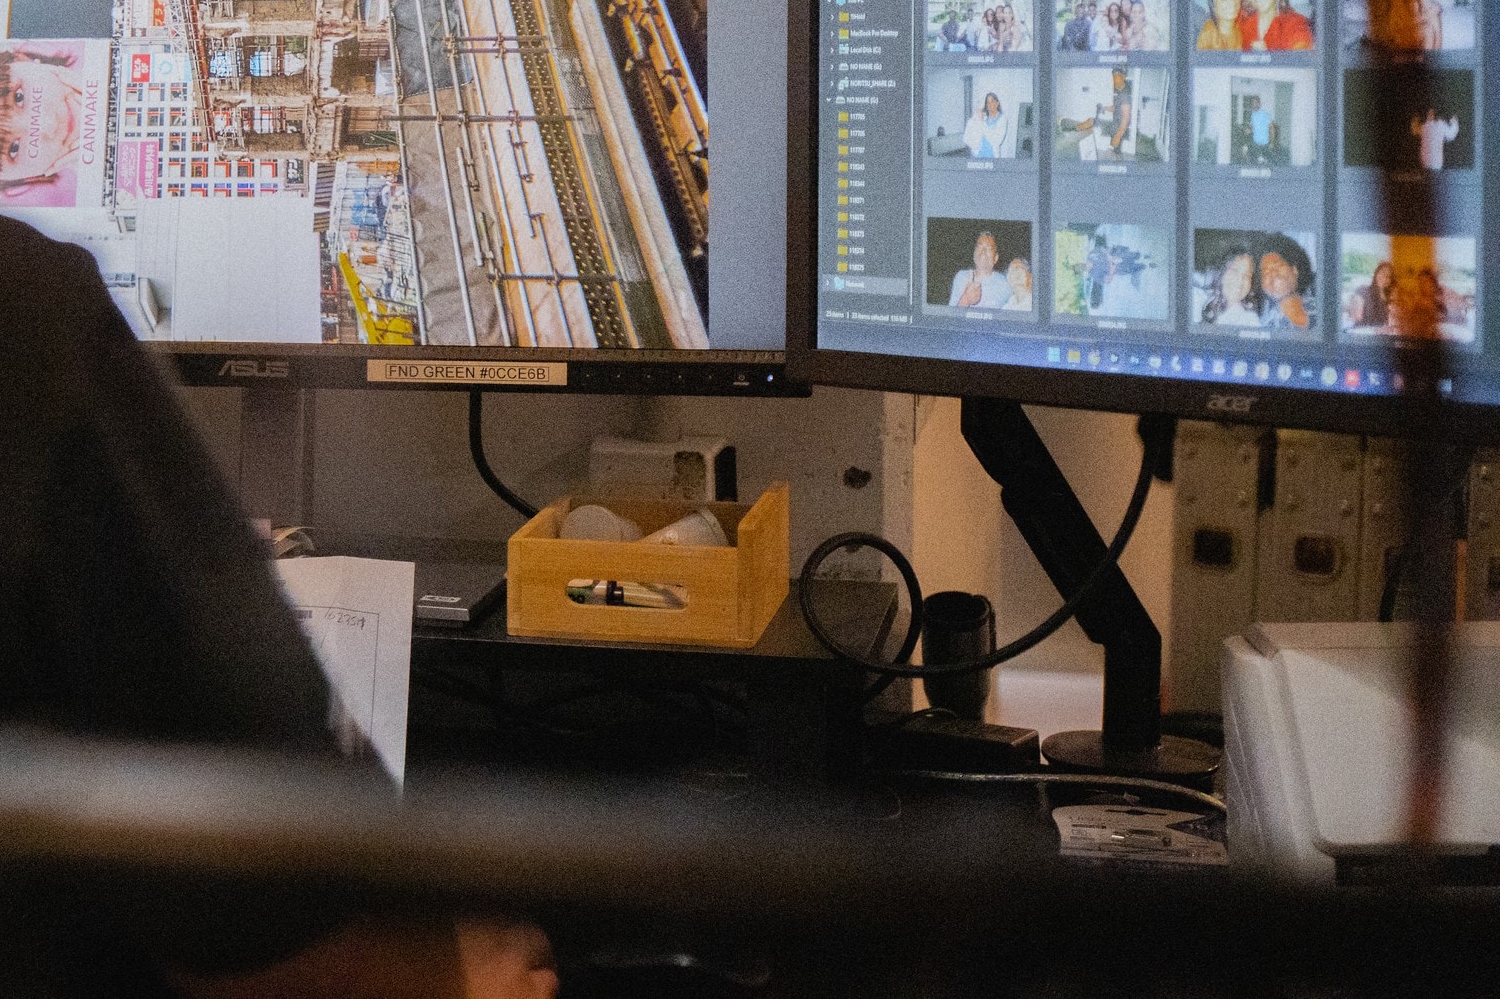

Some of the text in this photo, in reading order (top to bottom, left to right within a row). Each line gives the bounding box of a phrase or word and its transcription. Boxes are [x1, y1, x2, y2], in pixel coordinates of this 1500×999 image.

[27, 84, 43, 160] CANMAKE
[81, 78, 99, 166] CANMAKE
[218, 360, 289, 379] ASUS
[388, 365, 547, 382] FND GREEN #0CCE6B
